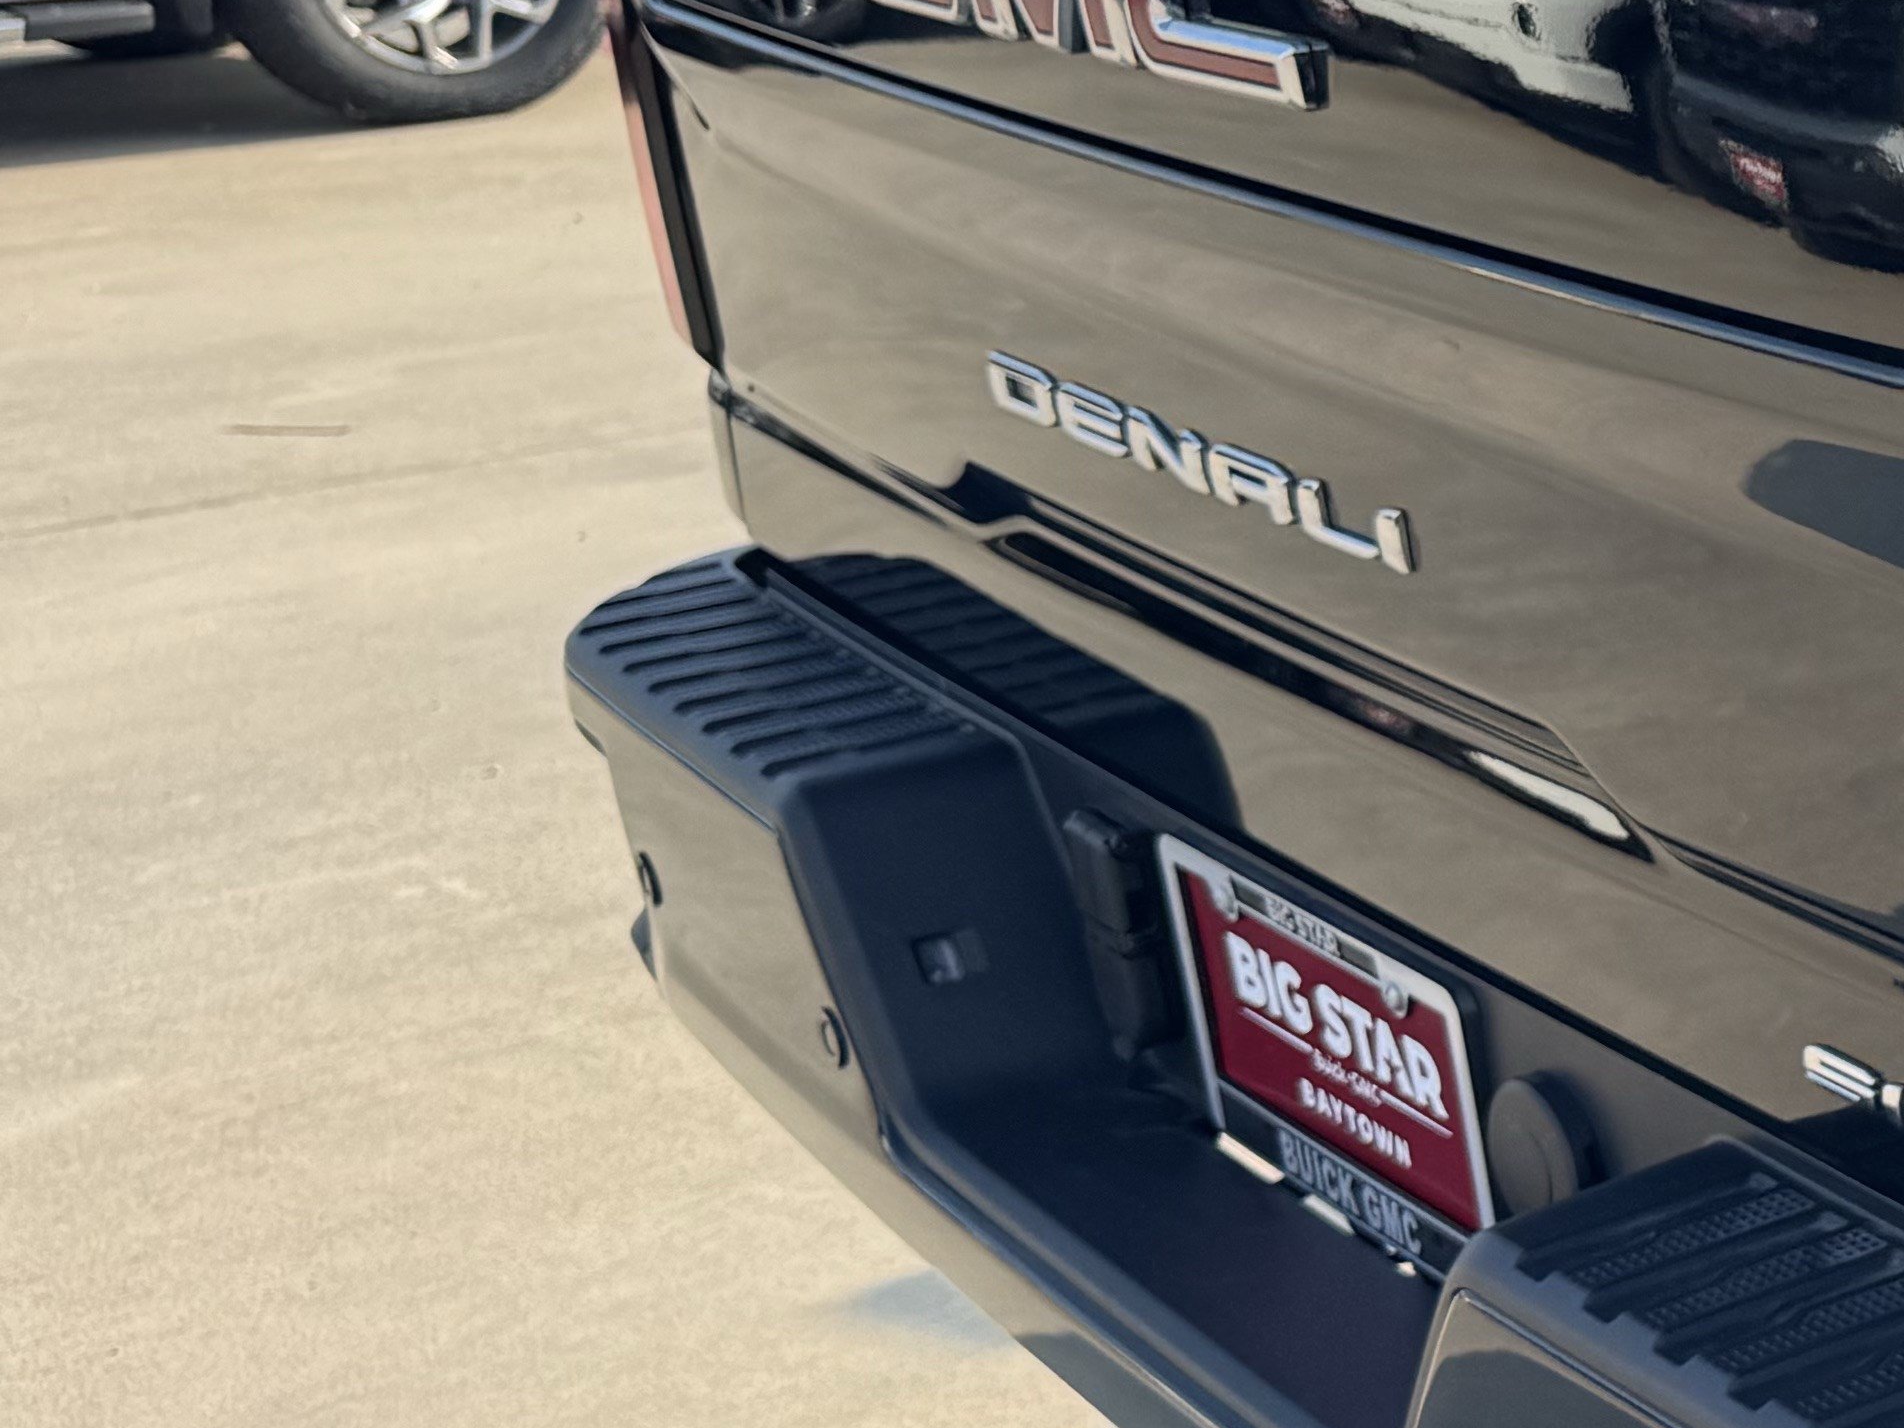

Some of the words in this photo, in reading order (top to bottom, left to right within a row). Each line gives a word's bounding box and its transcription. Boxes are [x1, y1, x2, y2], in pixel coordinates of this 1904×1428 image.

[986, 349, 1416, 573] DENALI
[1223, 930, 1313, 1034] BIG
[1313, 983, 1449, 1121] STAR
[1277, 1126, 1360, 1217] BUICK
[1361, 1178, 1423, 1257] GMC
[1300, 1077, 1412, 1168] BAYTOWN
